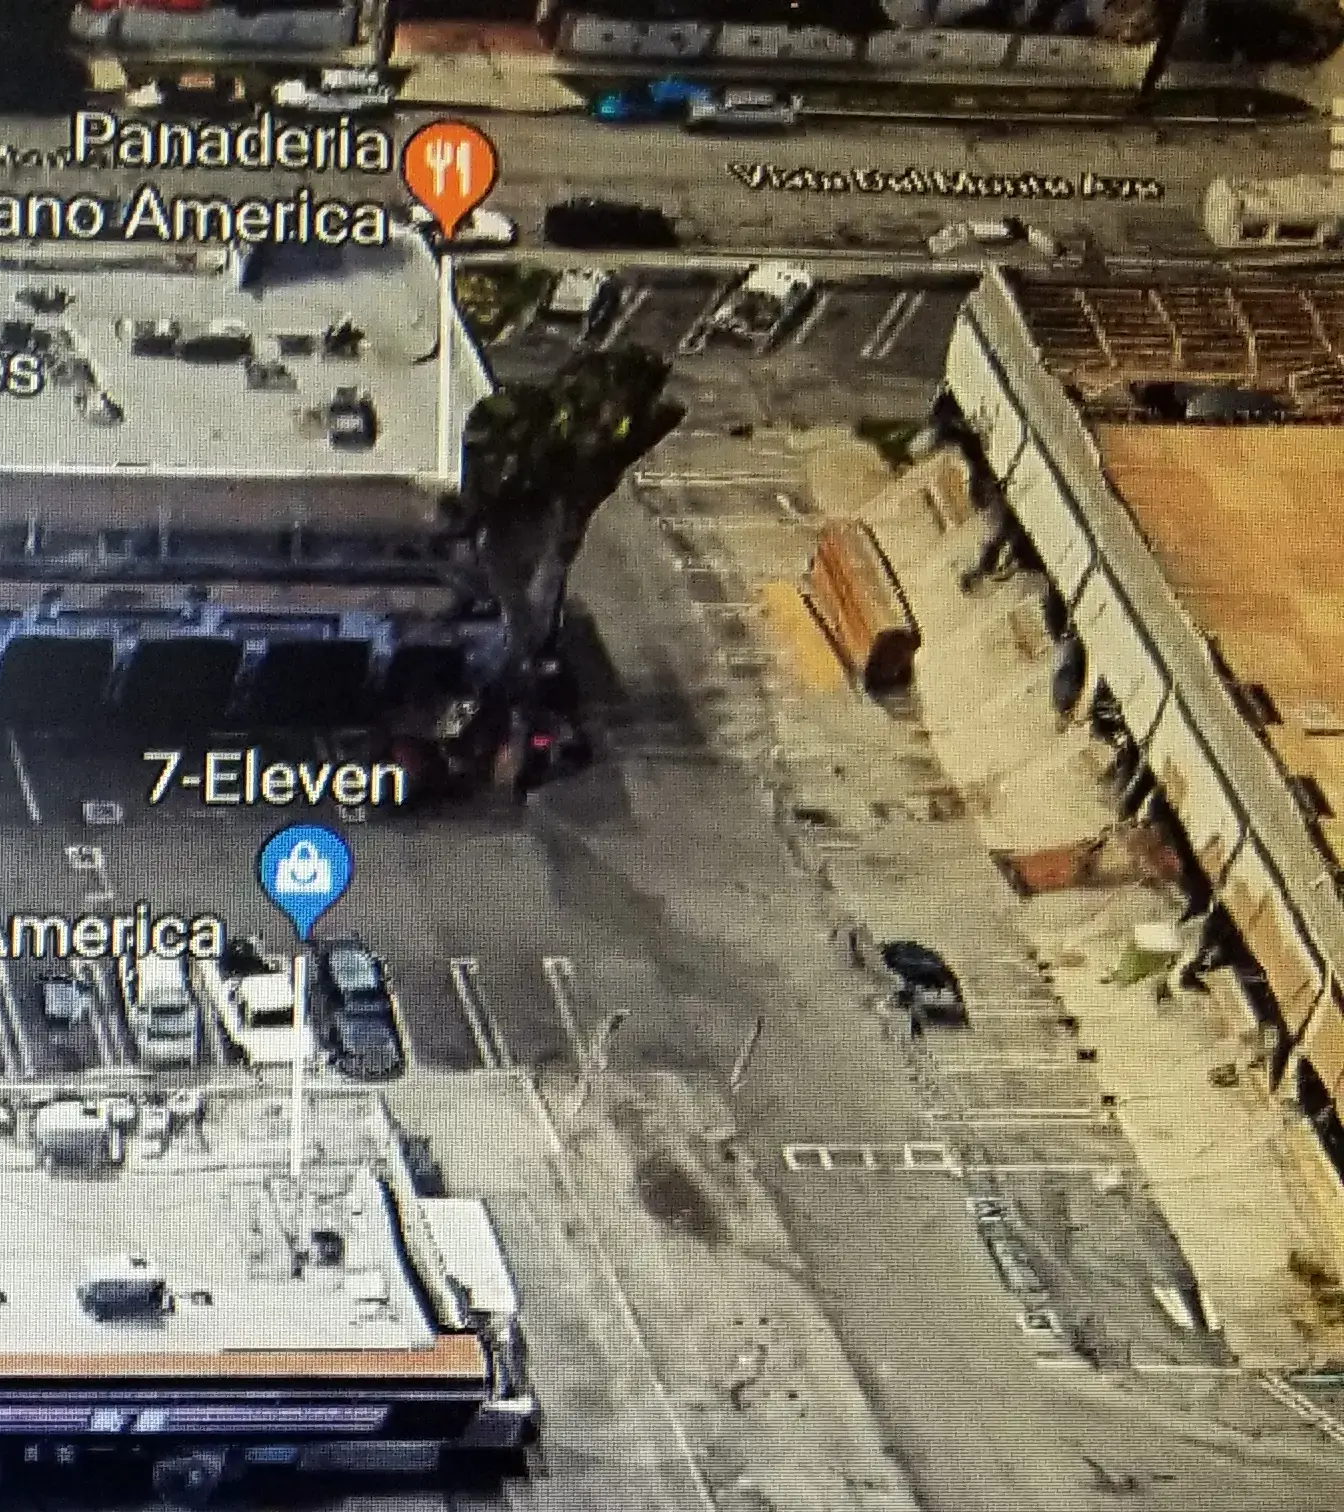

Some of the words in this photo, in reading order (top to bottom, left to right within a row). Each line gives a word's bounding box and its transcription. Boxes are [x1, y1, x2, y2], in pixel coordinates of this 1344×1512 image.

[74, 111, 392, 172] Panaderia
[124, 186, 390, 245] America
[141, 750, 405, 805] 7-Eleven
